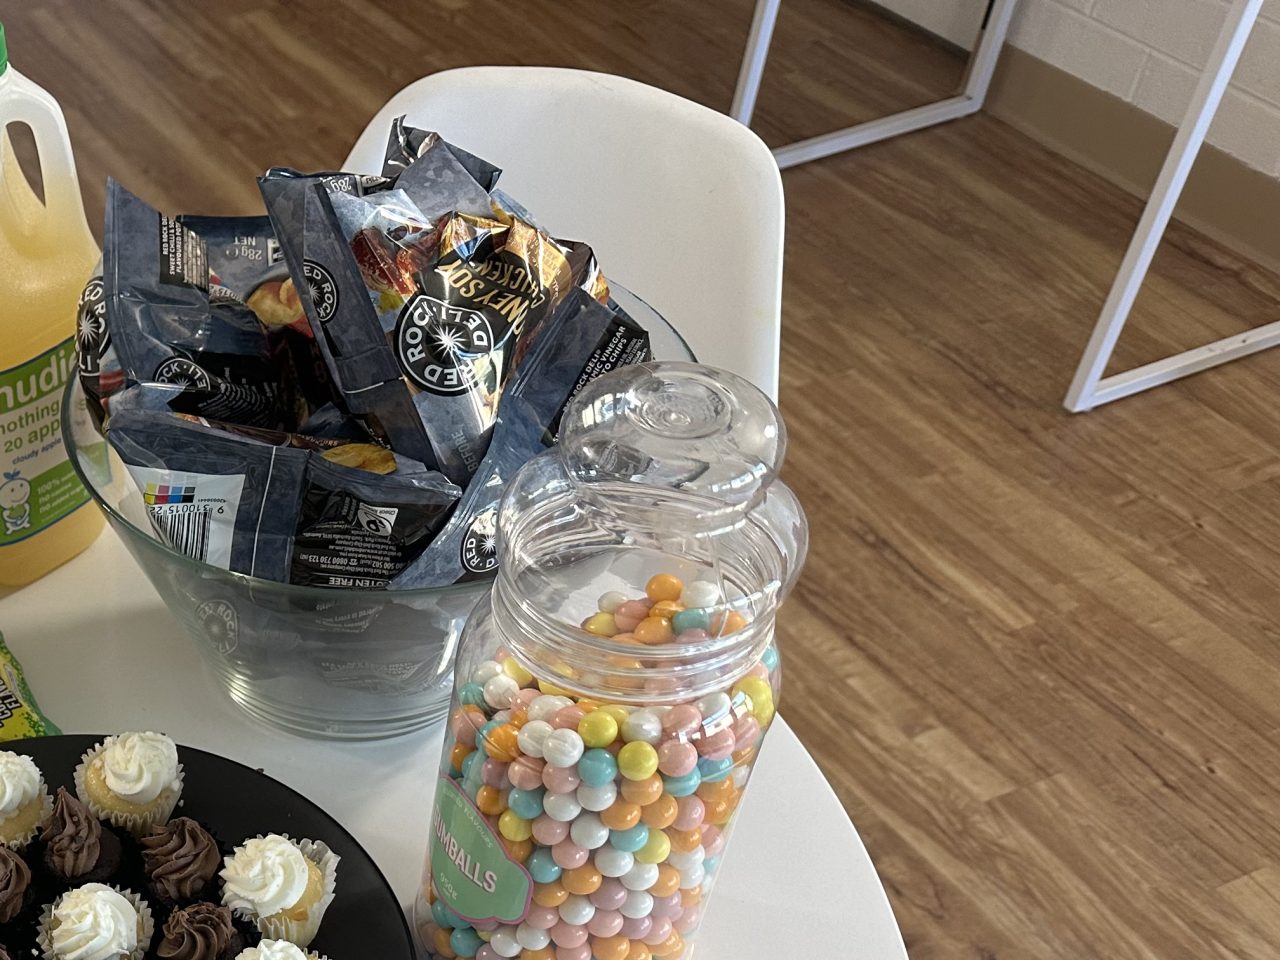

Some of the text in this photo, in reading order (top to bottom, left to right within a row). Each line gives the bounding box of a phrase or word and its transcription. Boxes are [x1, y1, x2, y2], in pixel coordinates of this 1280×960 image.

[233, 236, 256, 246] NET
[241, 248, 262, 261] 28g
[437, 259, 485, 298] SOY
[304, 268, 336, 319] ED ROCK
[441, 304, 489, 347] DELI
[602, 325, 627, 361] VINEGAR
[609, 337, 627, 361] CHIPS
[189, 364, 206, 389] ELI
[3, 418, 61, 454] 20 app
[12, 438, 62, 466] cloudy apple
[169, 504, 211, 514] 310015
[320, 556, 332, 564] 730
[466, 537, 480, 568] RED
[329, 576, 386, 587] UTEN FREE
